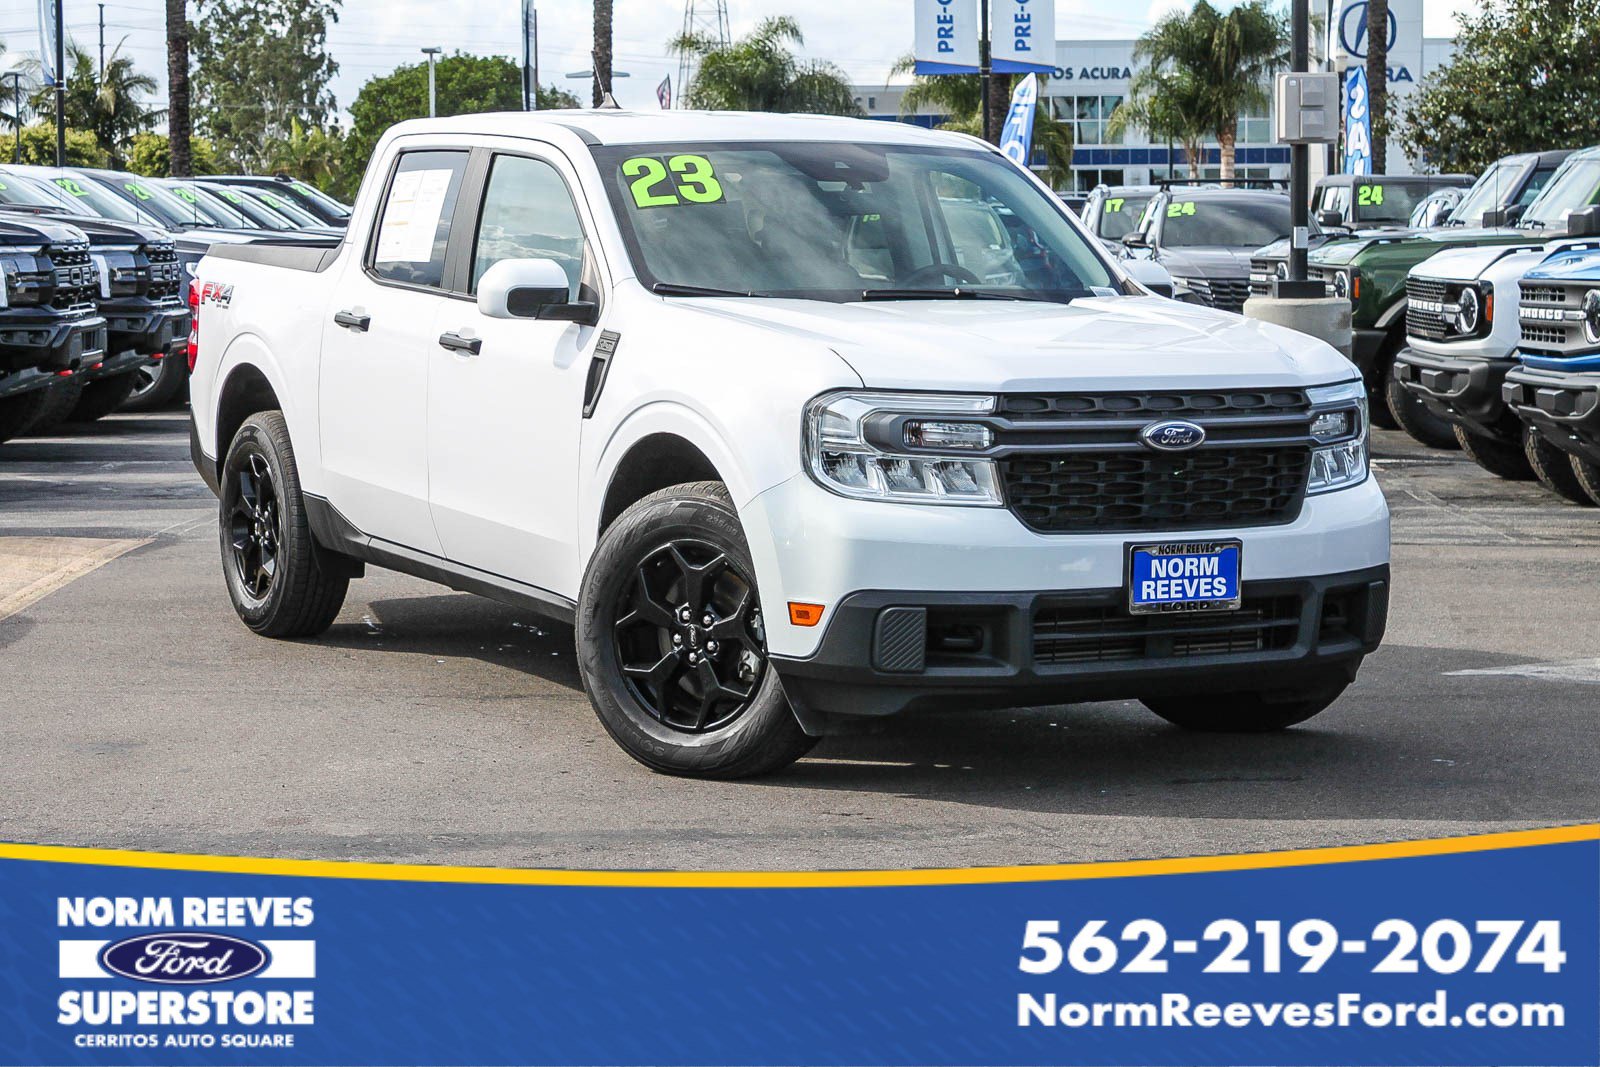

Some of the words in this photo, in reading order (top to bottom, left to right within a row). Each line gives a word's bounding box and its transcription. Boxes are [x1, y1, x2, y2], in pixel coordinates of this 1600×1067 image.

[1053, 67, 1074, 80] OS
[1079, 67, 1132, 80] ACURA
[622, 154, 723, 208] 23
[1358, 185, 1384, 206] 24
[1105, 198, 1125, 213] 17
[1167, 201, 1196, 218] 24
[200, 281, 235, 305] FX4
[1408, 298, 1443, 313] BRONCO
[1519, 306, 1563, 321] BRONCO
[1161, 427, 1193, 444] Ford
[1158, 545, 1184, 555] NORM
[1186, 543, 1216, 554] REEVES
[1151, 556, 1219, 579] NORM
[1141, 577, 1227, 600] REEVES
